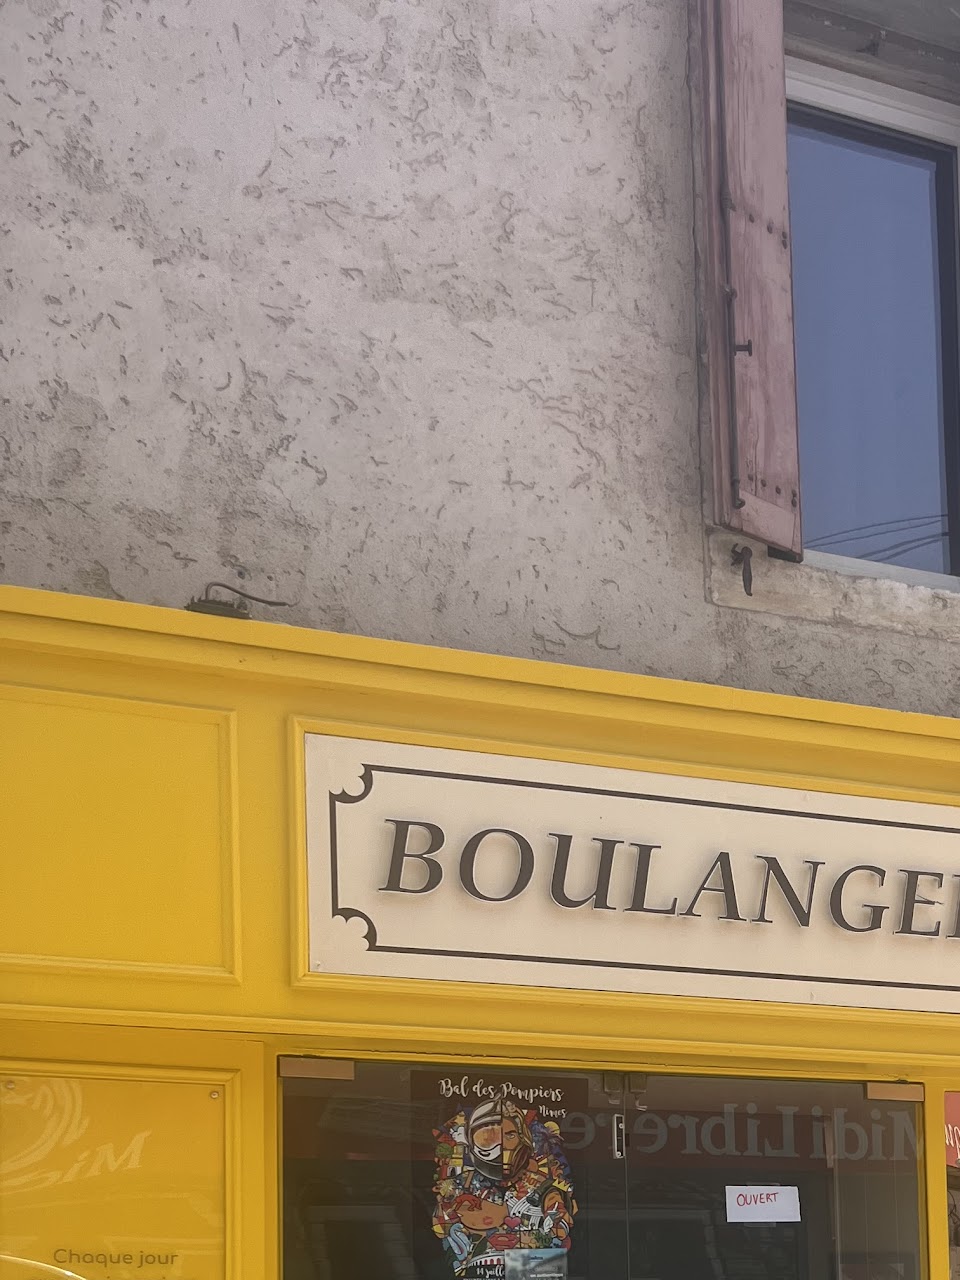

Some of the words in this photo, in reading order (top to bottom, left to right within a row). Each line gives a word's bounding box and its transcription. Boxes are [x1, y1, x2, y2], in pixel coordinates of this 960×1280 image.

[438, 1076, 469, 1097] Bal
[472, 1079, 497, 1098] des
[500, 1082, 564, 1103] Pompiers
[736, 1192, 779, 1207] OUVERT
[53, 1249, 133, 1268] Chaque
[138, 1251, 178, 1268] jour
